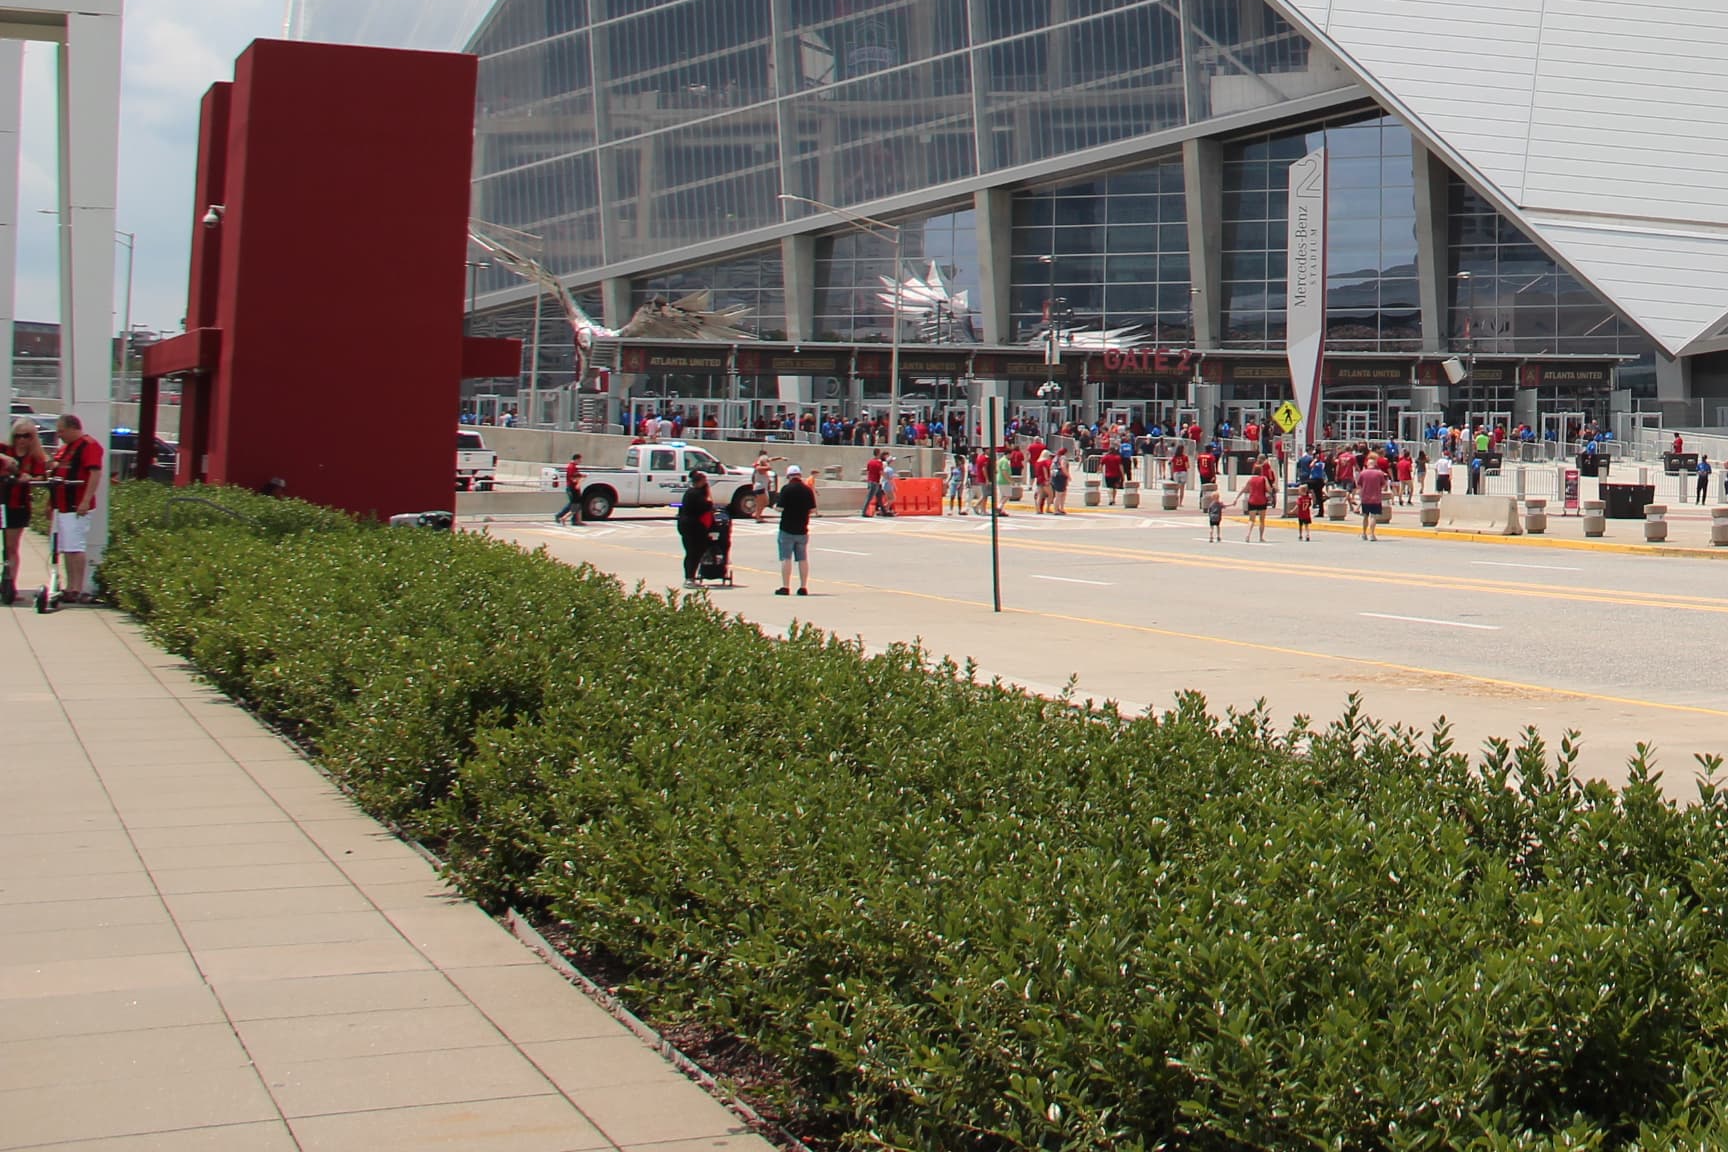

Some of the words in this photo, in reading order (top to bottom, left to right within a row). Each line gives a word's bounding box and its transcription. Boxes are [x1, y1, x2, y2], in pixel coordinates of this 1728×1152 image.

[1295, 152, 1322, 199] 2
[1294, 205, 1309, 308] Mercedes-Benz
[1310, 228, 1318, 286] STADIUM
[650, 357, 687, 367] ATLANTA
[1103, 348, 1169, 371] GATE
[1176, 348, 1192, 371] 2
[1338, 369, 1371, 378] ATLANTA
[1543, 371, 1575, 380] ATLANTA
[1576, 371, 1603, 380] UNITED
